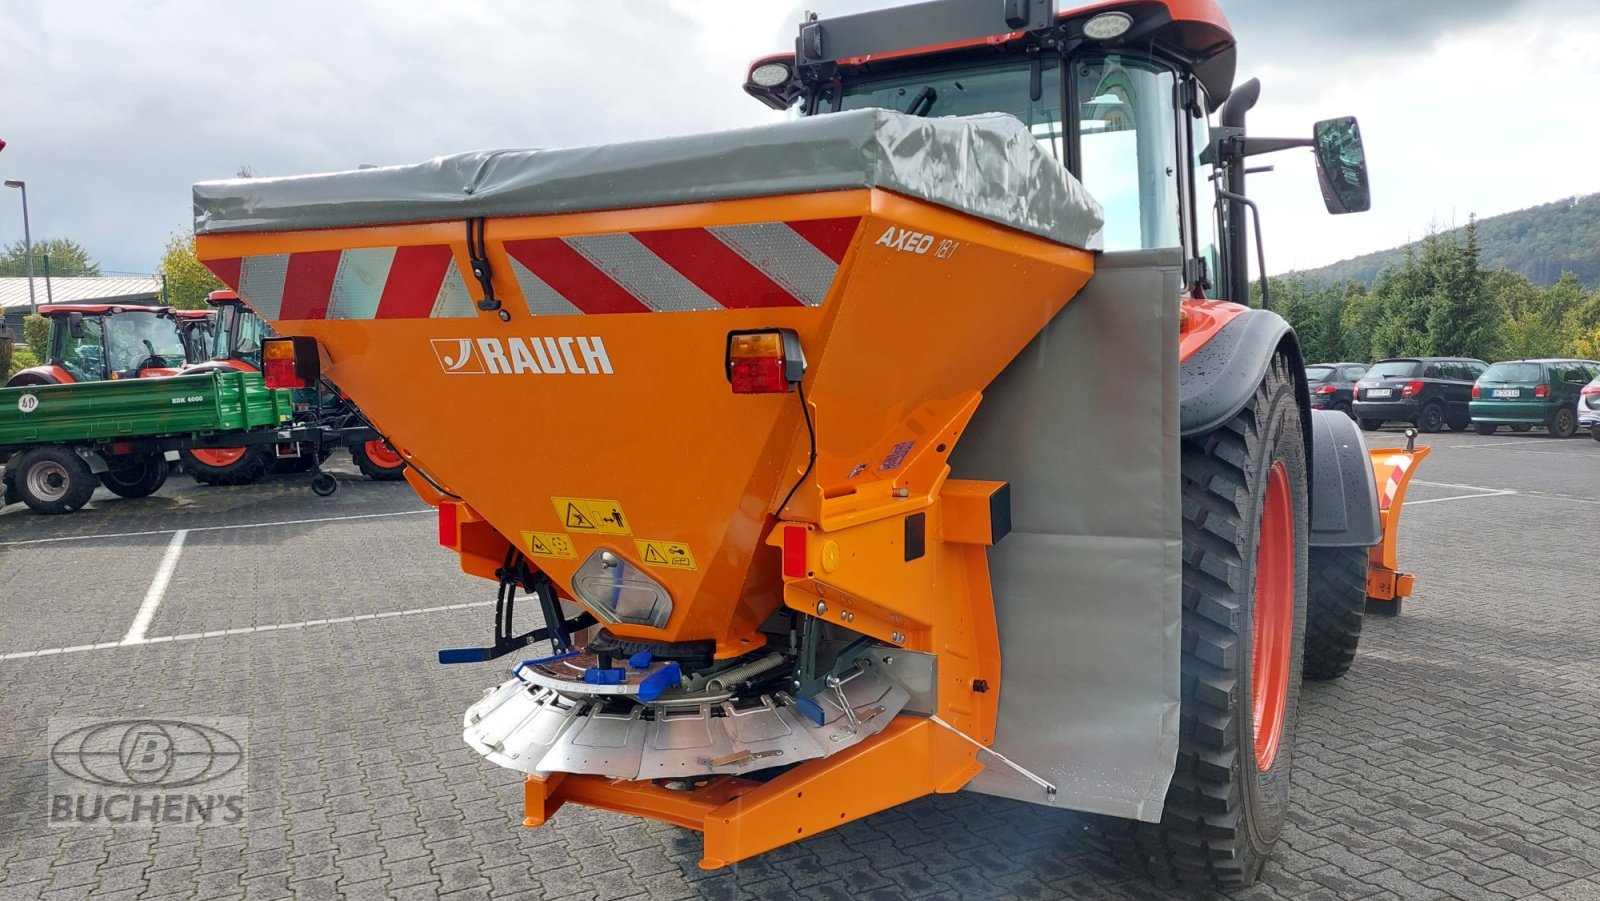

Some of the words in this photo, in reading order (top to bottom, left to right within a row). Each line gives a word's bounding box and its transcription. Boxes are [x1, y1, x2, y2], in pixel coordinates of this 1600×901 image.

[875, 226, 934, 254] AXEO
[476, 336, 614, 375] RAUCH
[21, 397, 35, 409] 40
